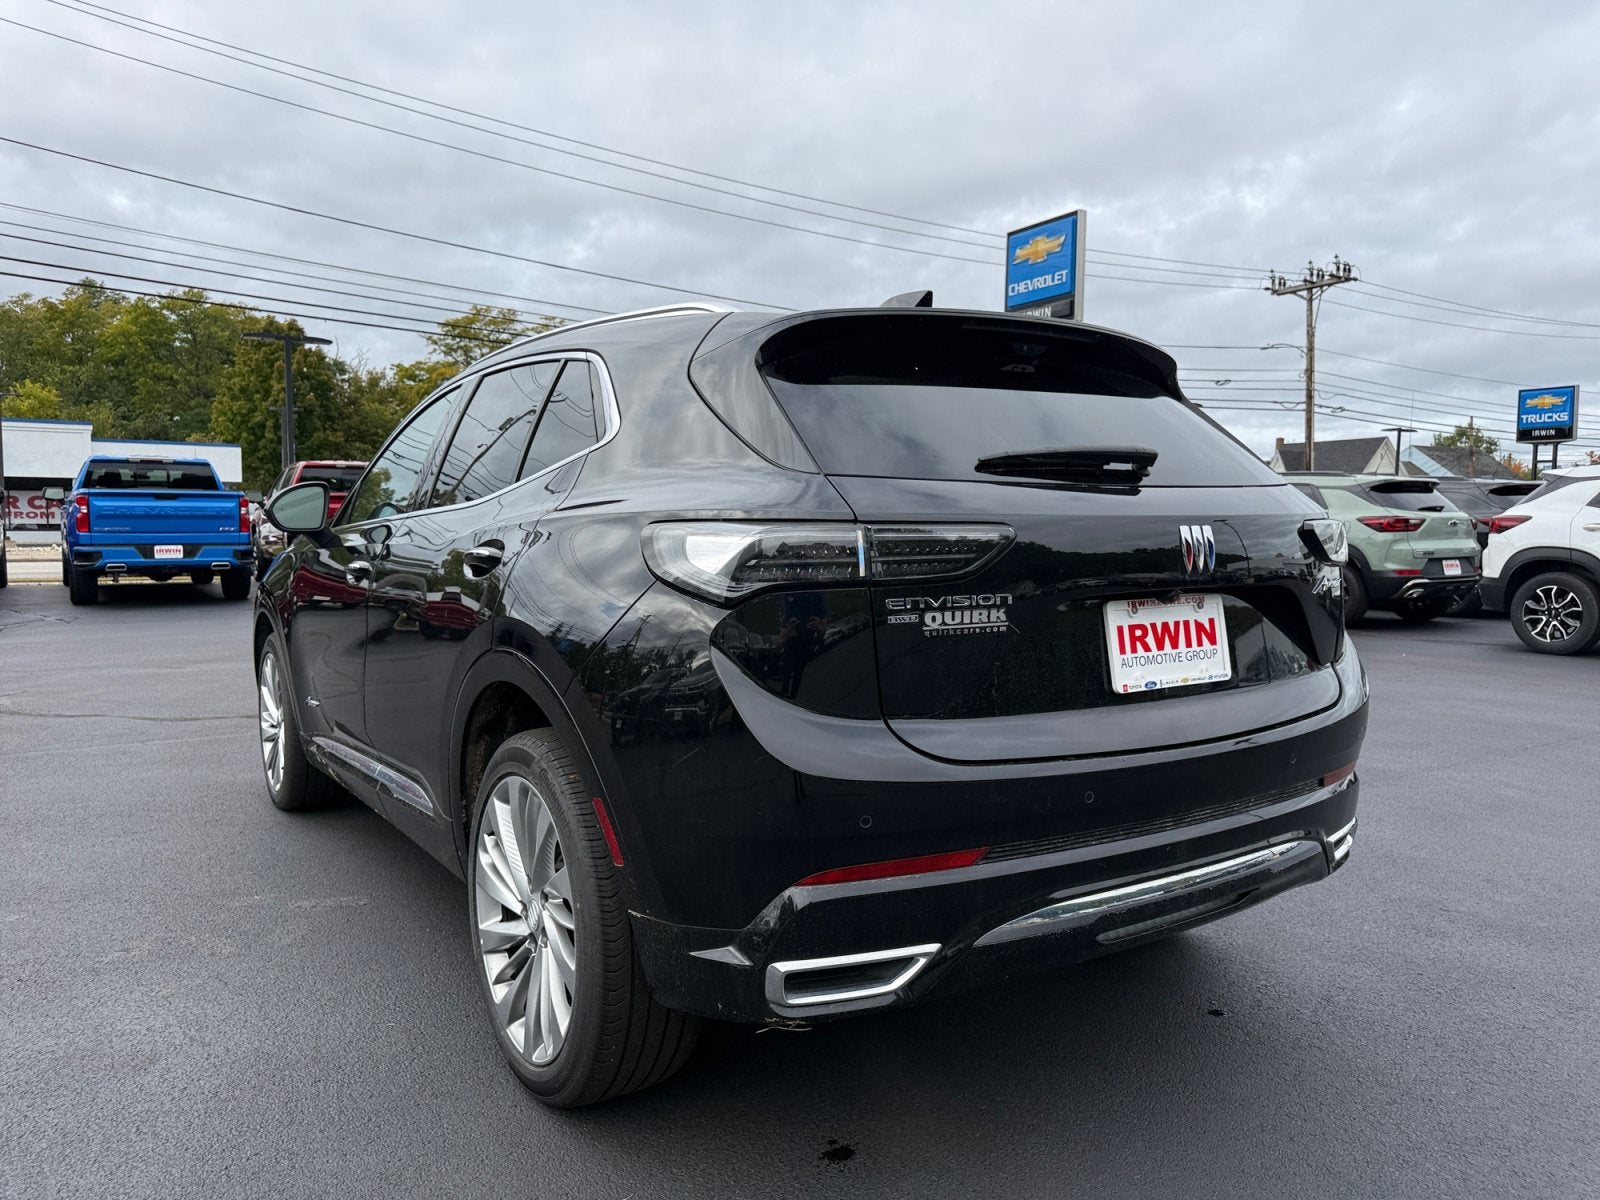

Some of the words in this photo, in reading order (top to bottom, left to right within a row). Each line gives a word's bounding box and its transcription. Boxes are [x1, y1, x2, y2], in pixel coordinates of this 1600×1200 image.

[1008, 269, 1069, 296] CHEVROLET
[1521, 412, 1569, 424] TRUCKS
[885, 593, 1013, 610] ENVISION
[924, 608, 1008, 629] QUIRK
[924, 626, 1007, 638] quirkcars.com
[1116, 617, 1218, 656] IRWIN
[1120, 651, 1184, 669] AUTOMOTIVE
[1185, 648, 1218, 661] GROUP
